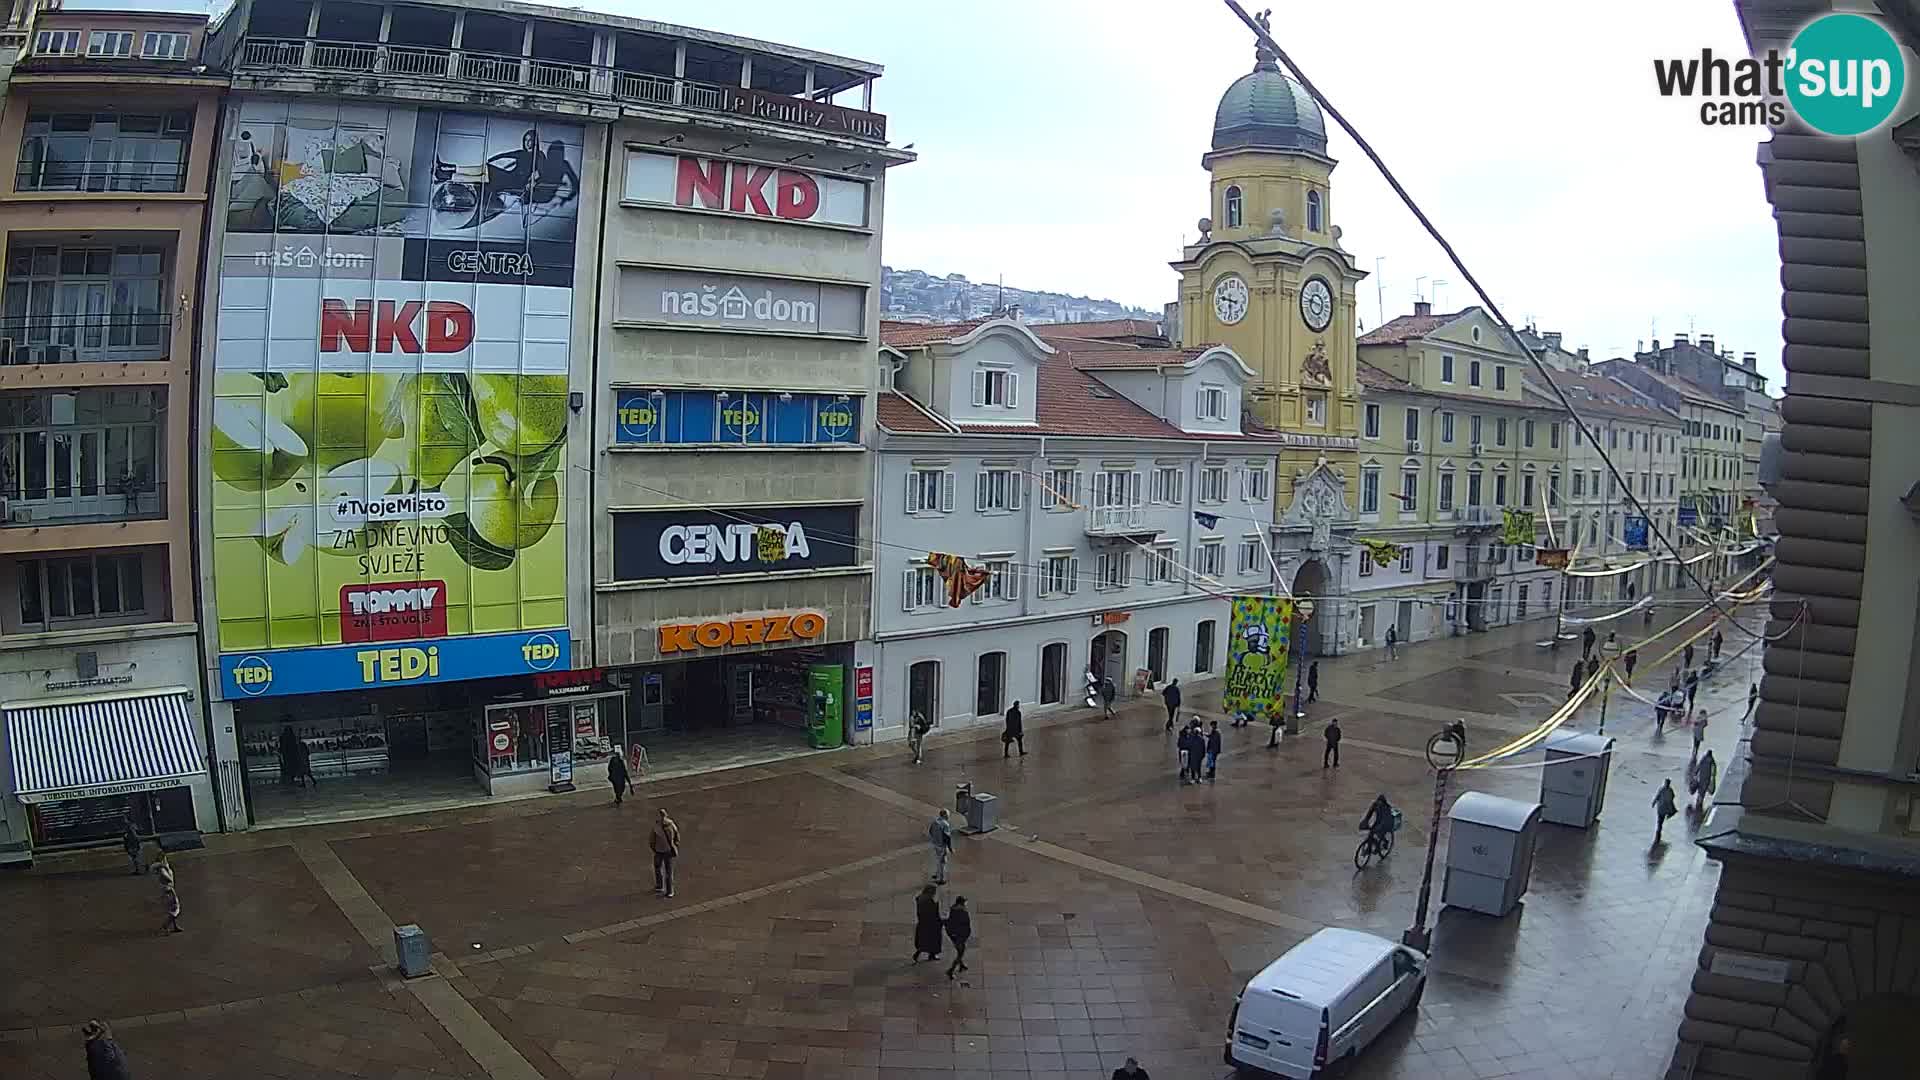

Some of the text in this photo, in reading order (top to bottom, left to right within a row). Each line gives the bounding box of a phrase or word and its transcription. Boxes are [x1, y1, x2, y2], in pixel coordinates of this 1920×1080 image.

[723, 89, 744, 111] Le
[675, 159, 820, 220] NKD
[255, 246, 365, 269] naš dom
[448, 250, 534, 276] CENTRA
[661, 284, 816, 323] naš dom
[319, 297, 477, 354] NKD
[618, 408, 657, 425] TEDi
[723, 409, 760, 426] TEDi
[819, 411, 853, 427] TEDi
[337, 498, 446, 517] #TvojeMisto
[333, 525, 450, 549] ZA DNEVNO
[359, 549, 425, 575] SVJEŽE
[348, 587, 439, 615] TOMMY
[659, 613, 825, 654] KORZO
[522, 642, 560, 661] TEDi
[232, 666, 273, 685] TEDi
[357, 646, 440, 683] TEDi
[88, 783, 146, 797] INFORMATIVNI
[149, 778, 182, 790] CENTAR
